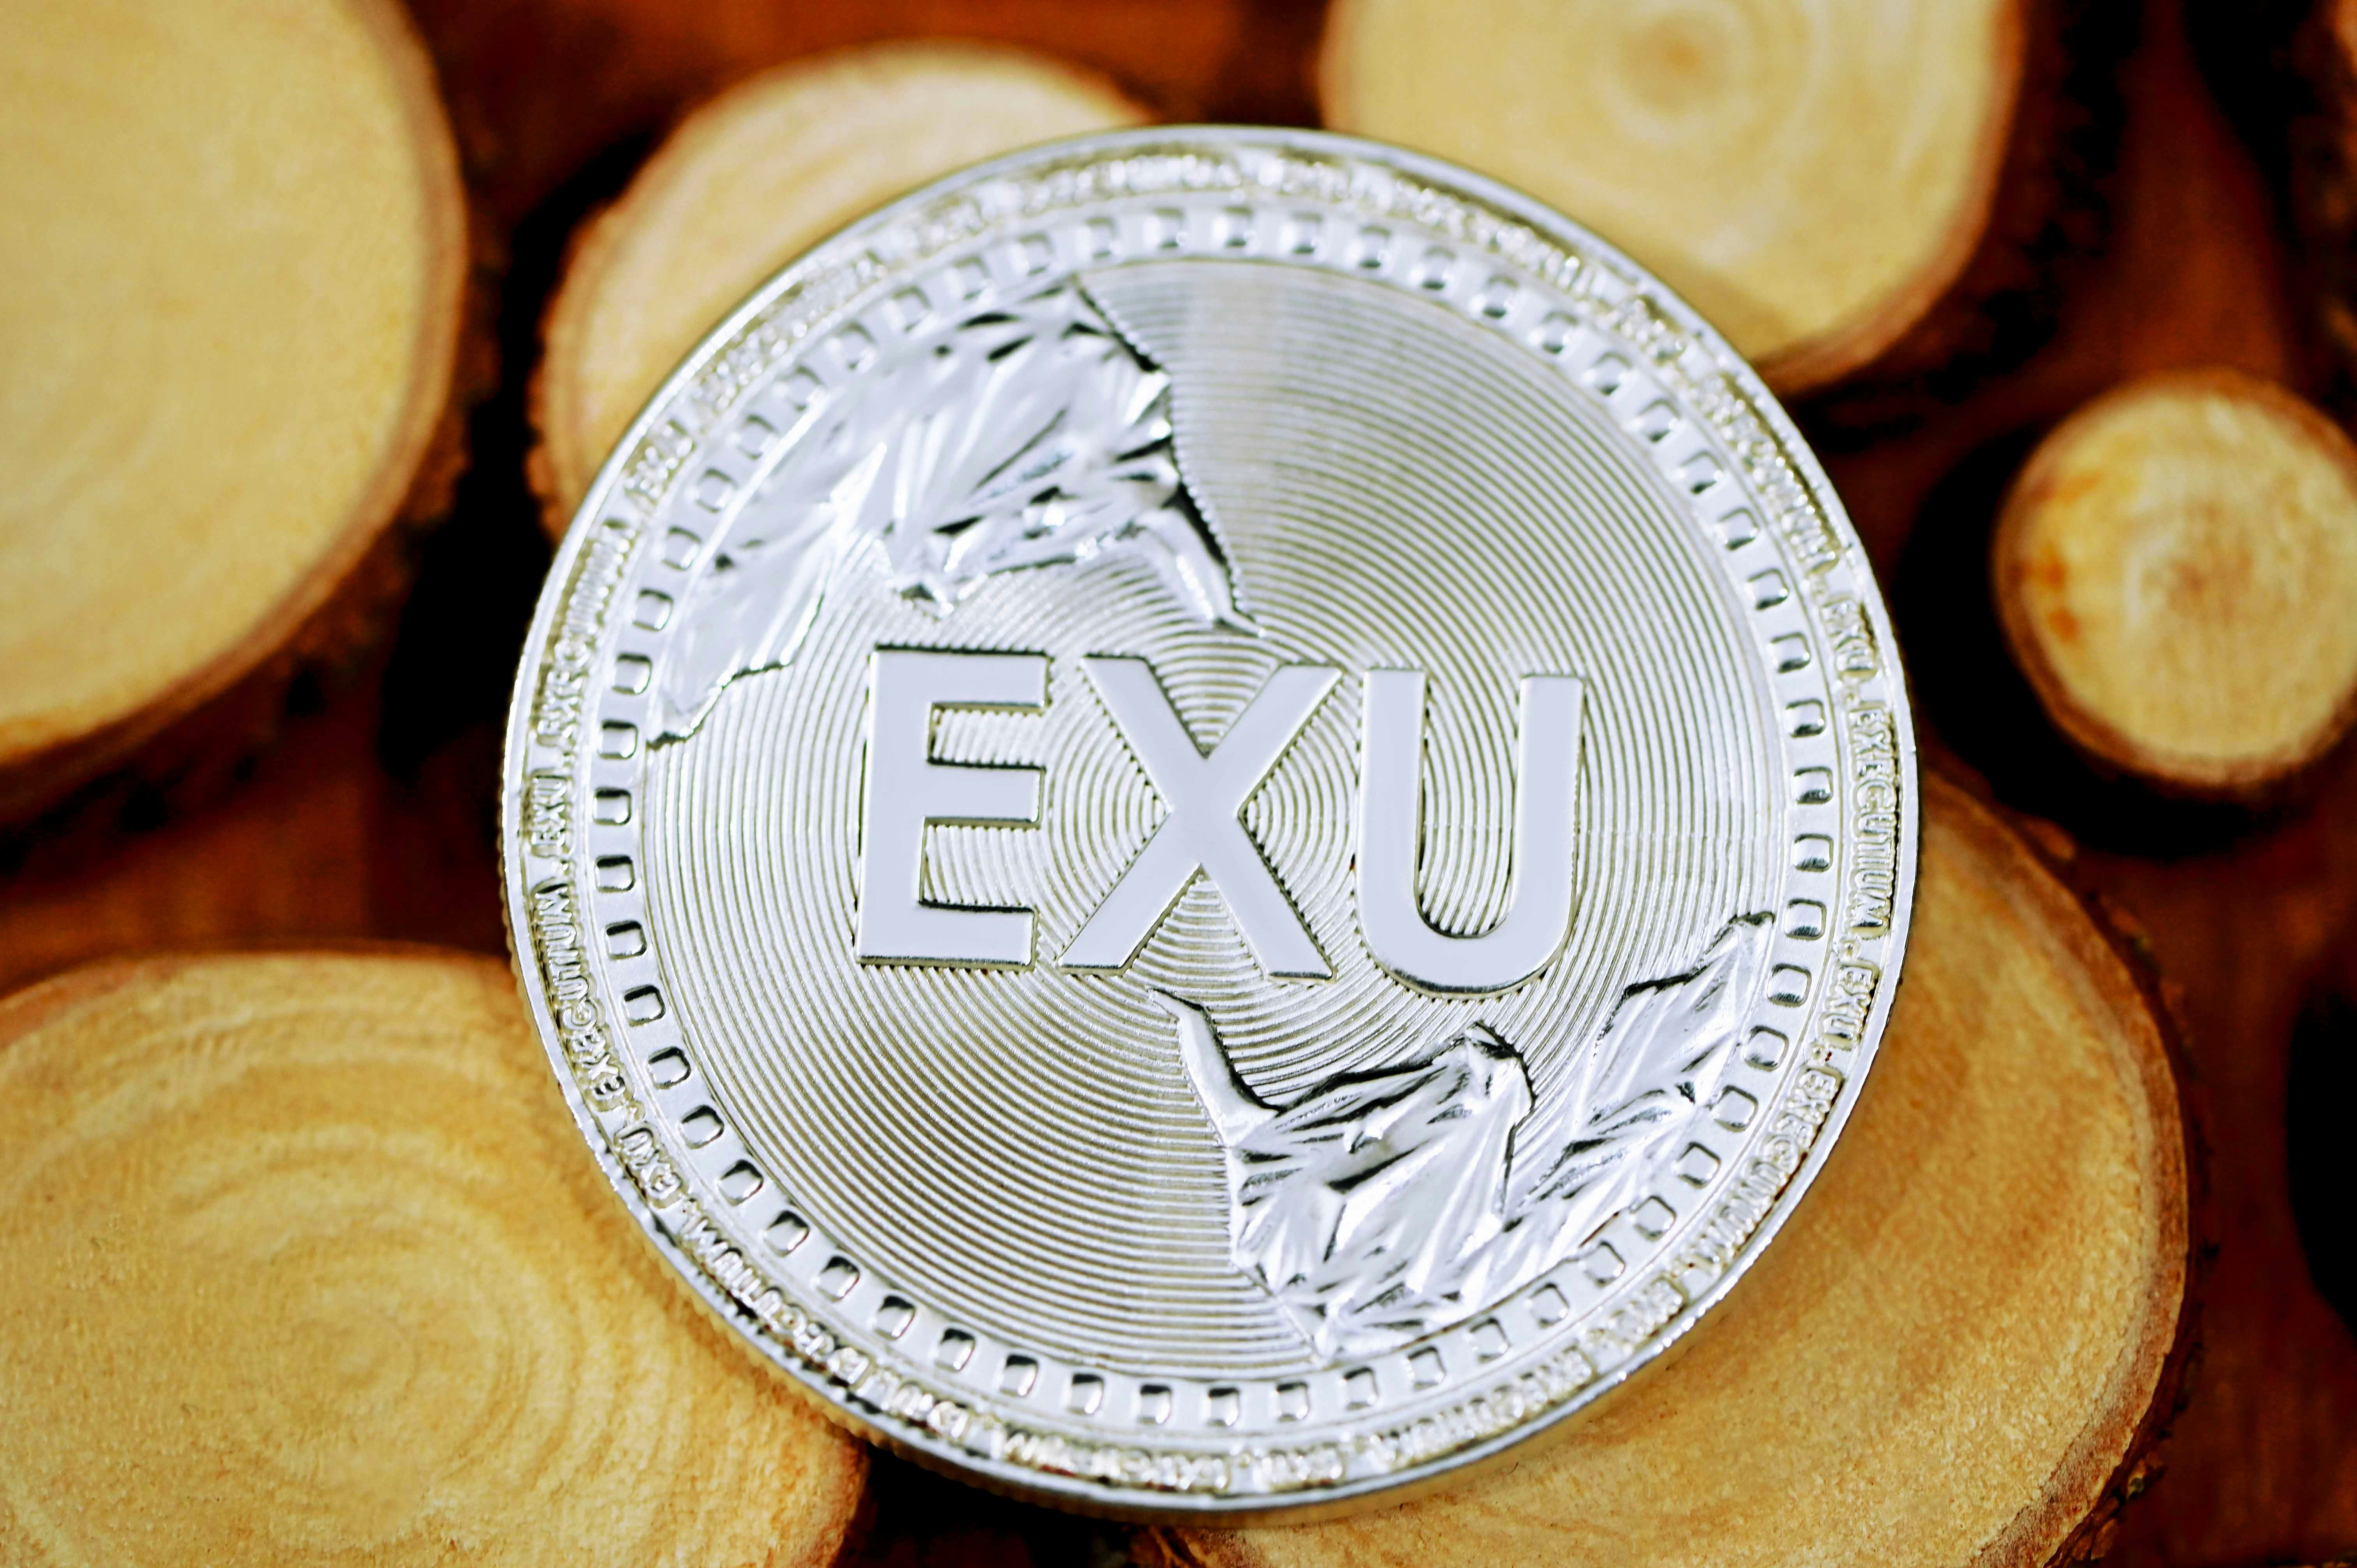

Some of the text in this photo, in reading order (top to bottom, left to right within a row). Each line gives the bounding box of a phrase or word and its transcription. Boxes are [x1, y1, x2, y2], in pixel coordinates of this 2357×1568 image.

[534, 773, 569, 847] EXU
[856, 648, 1584, 995] EXU
[1847, 705, 1895, 932] EXECUTIUM
[537, 881, 629, 1104] EXECUTIUM
[1818, 962, 1877, 1045] EXU
[616, 1122, 685, 1204] EXU
[1686, 1065, 1841, 1271] EXECUTIUM
